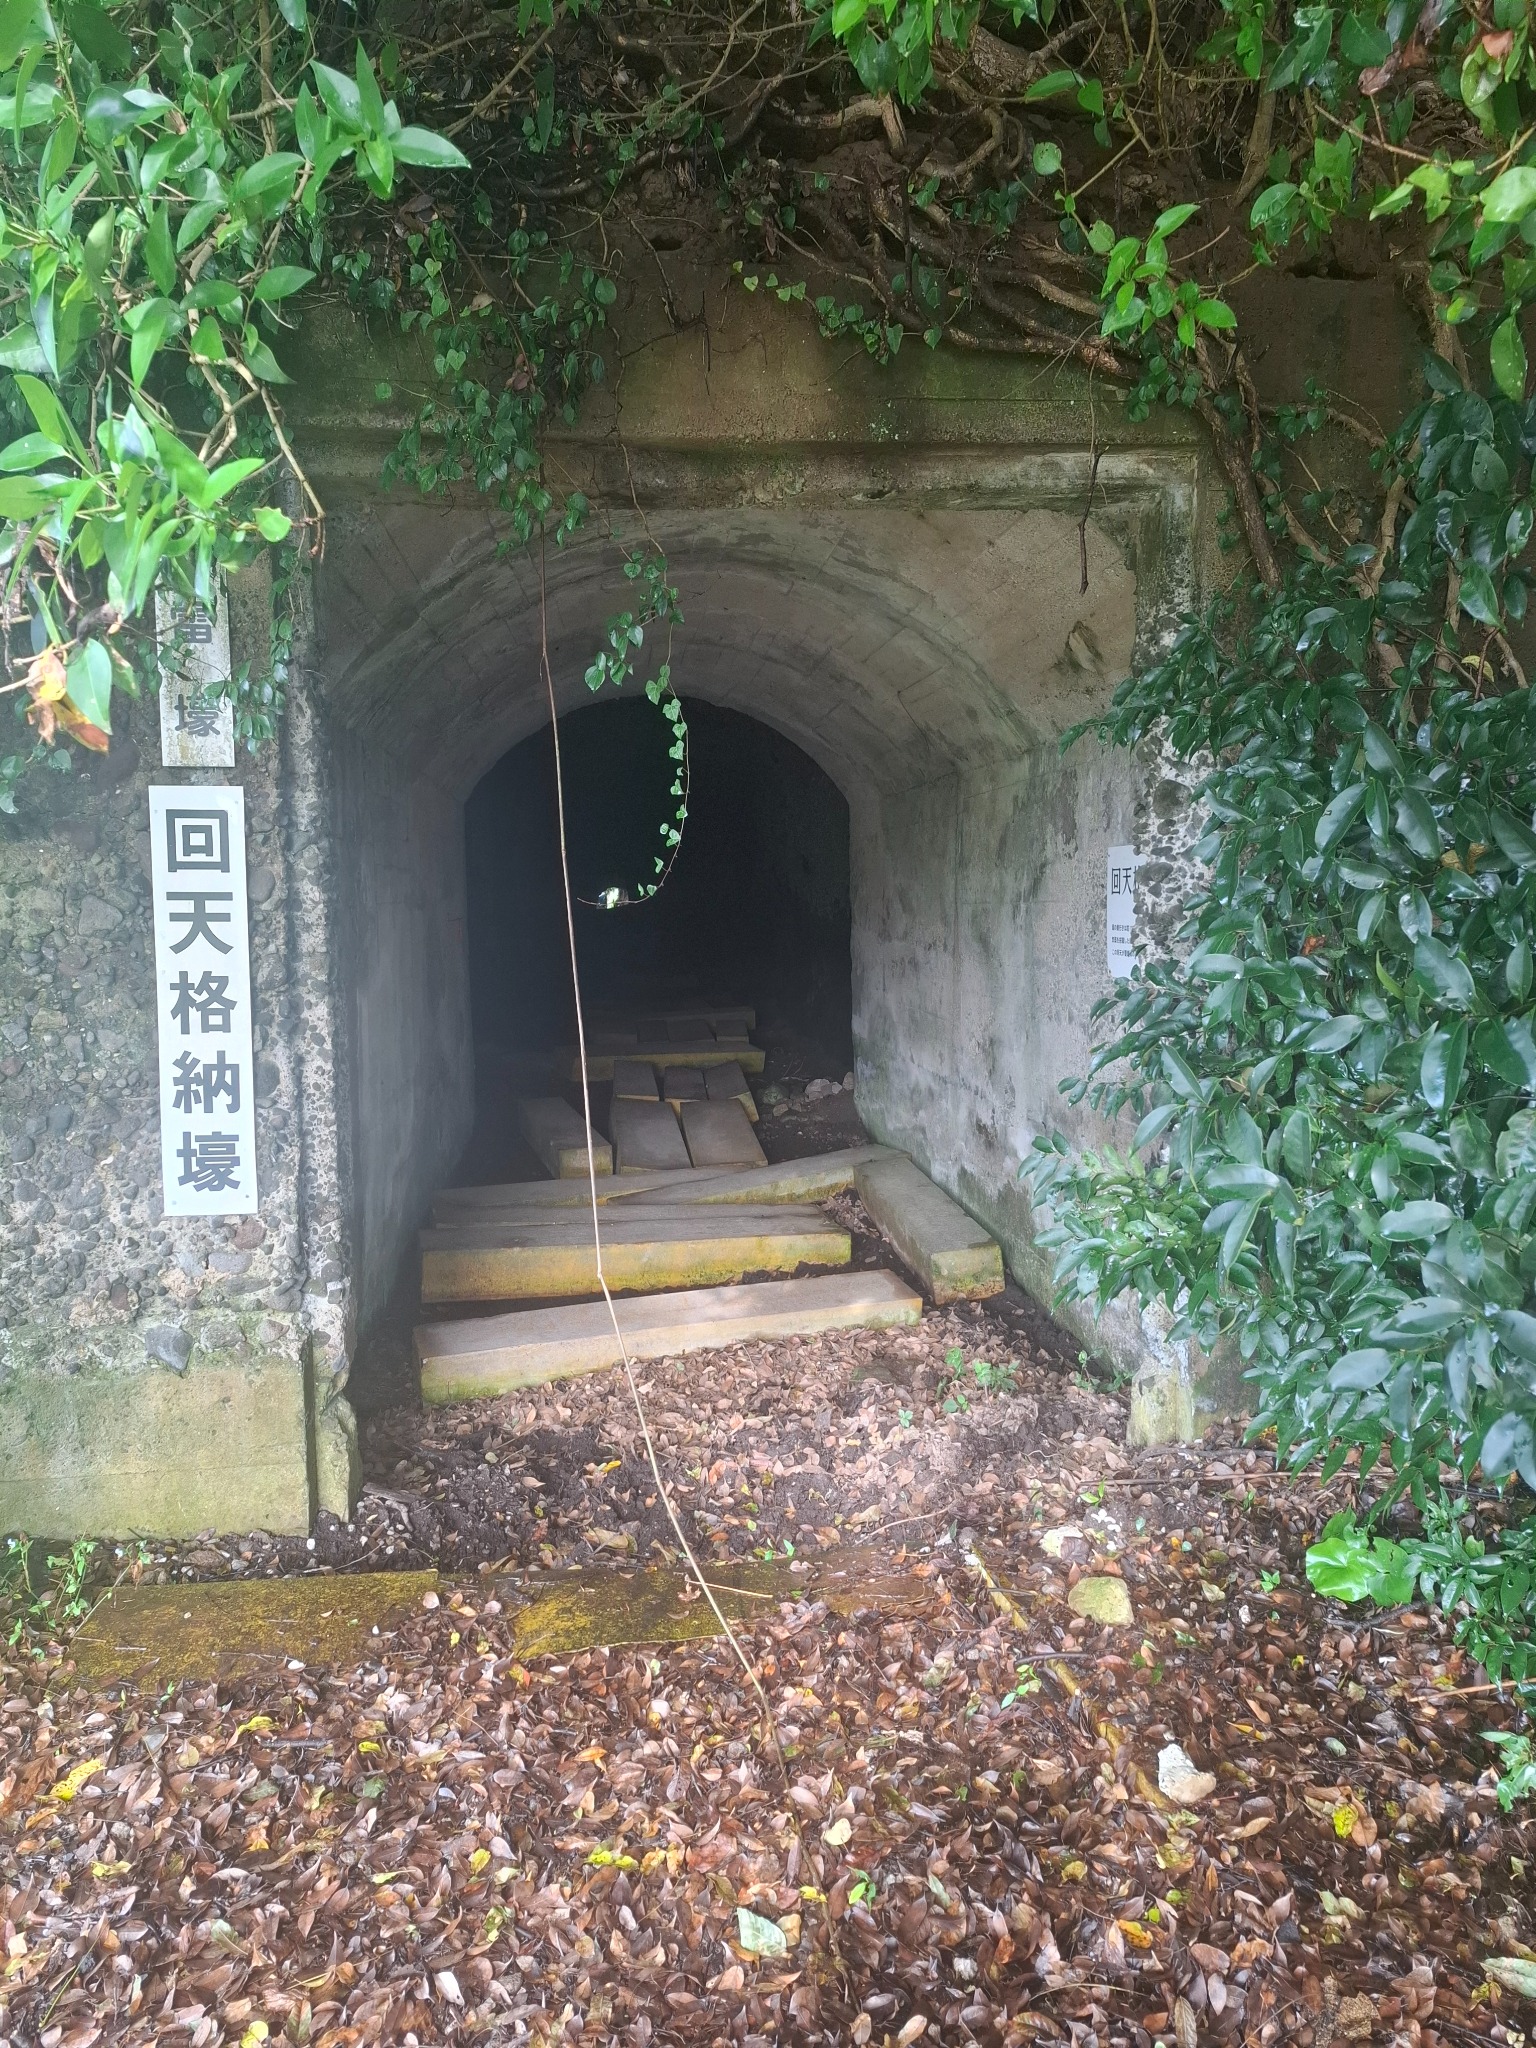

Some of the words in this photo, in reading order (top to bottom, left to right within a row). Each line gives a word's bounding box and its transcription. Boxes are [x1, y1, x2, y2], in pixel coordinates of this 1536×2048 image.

[165, 808, 241, 1192] 回天格納壕
